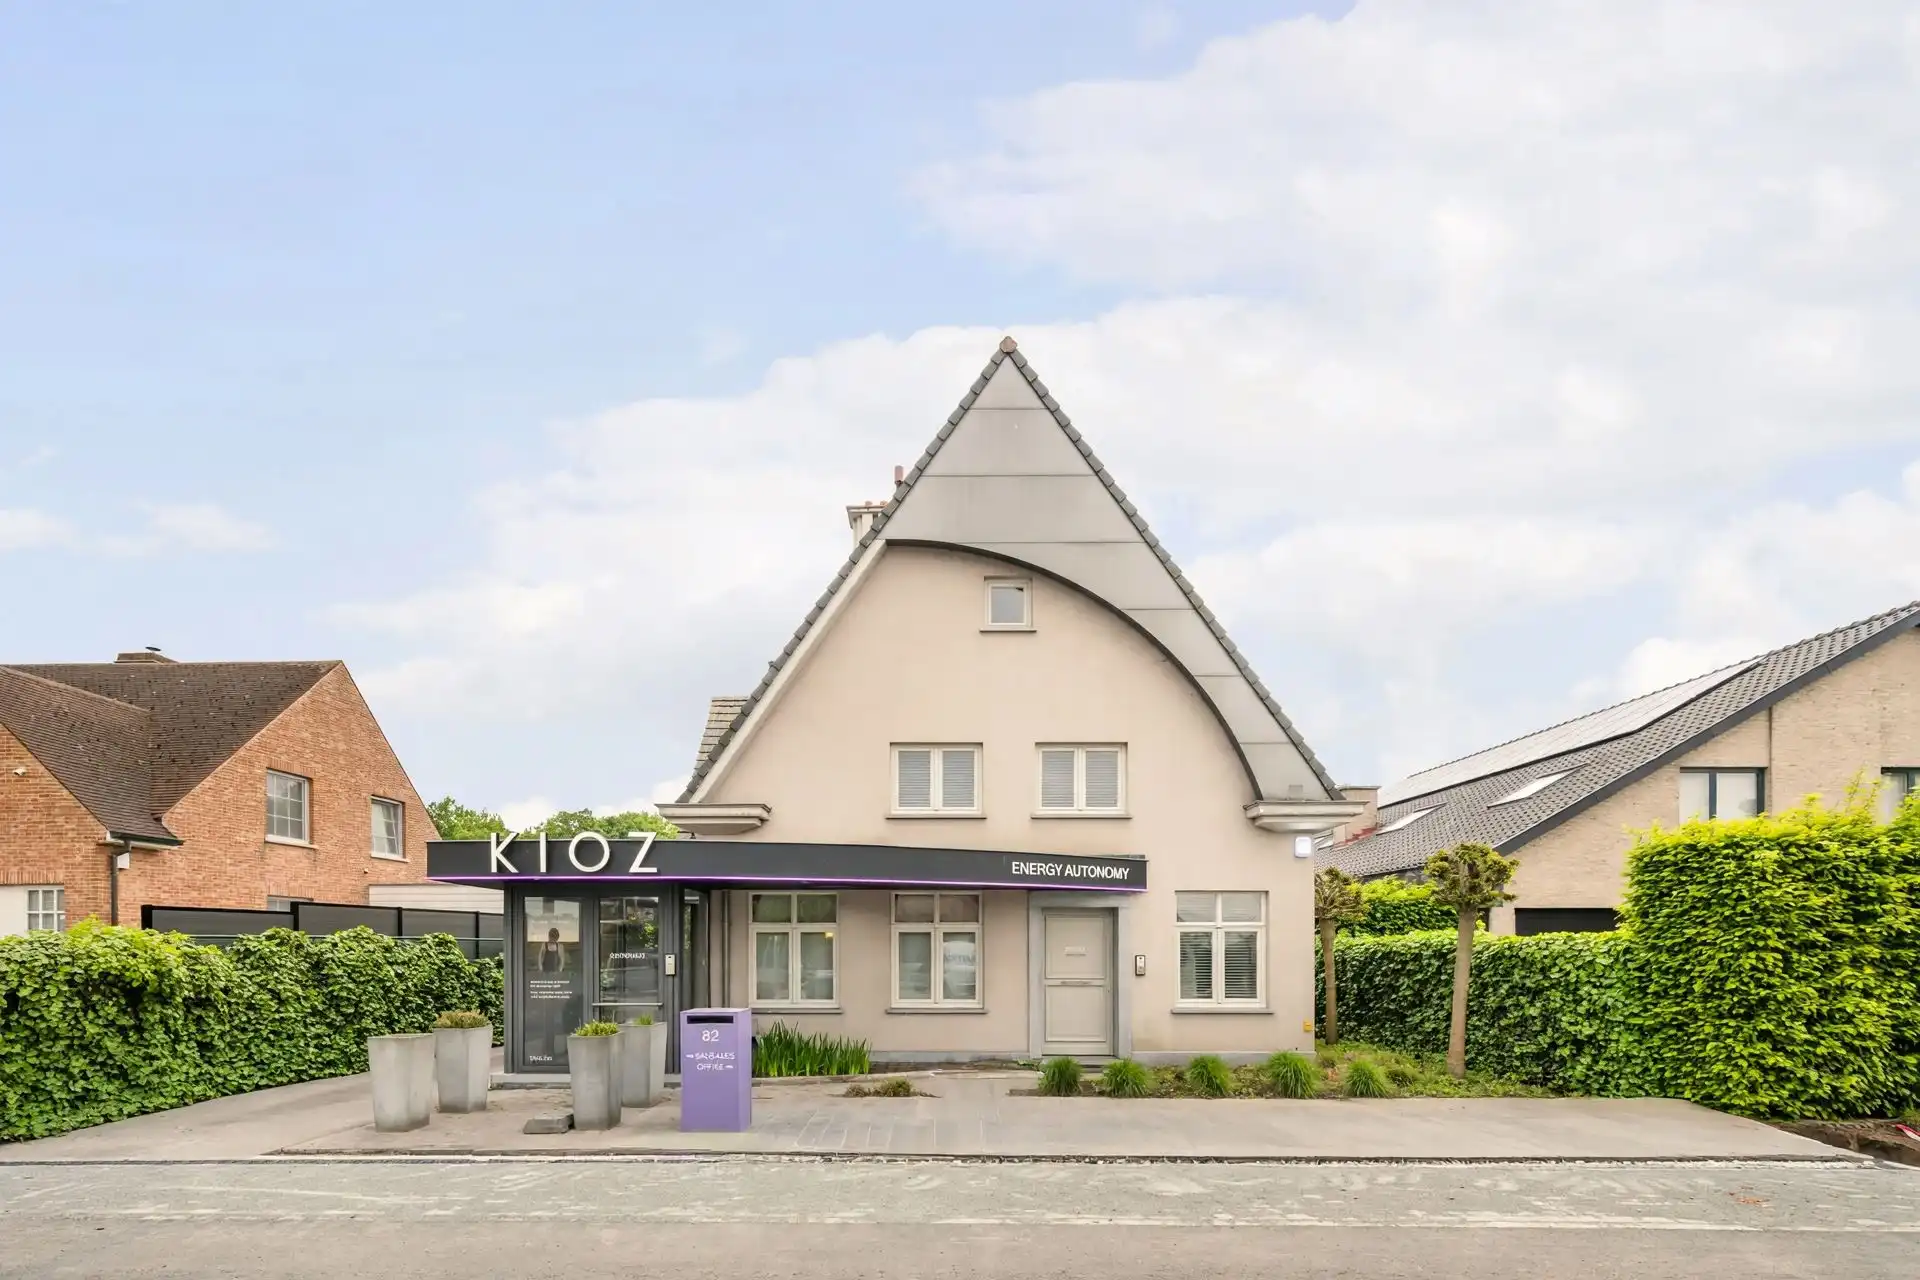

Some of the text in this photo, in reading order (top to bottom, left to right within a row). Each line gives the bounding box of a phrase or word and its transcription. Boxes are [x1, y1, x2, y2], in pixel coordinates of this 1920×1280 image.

[490, 831, 658, 873] KIOZ
[1012, 861, 1130, 880] ENERGY AUTONOMY
[702, 1029, 720, 1042] 82
